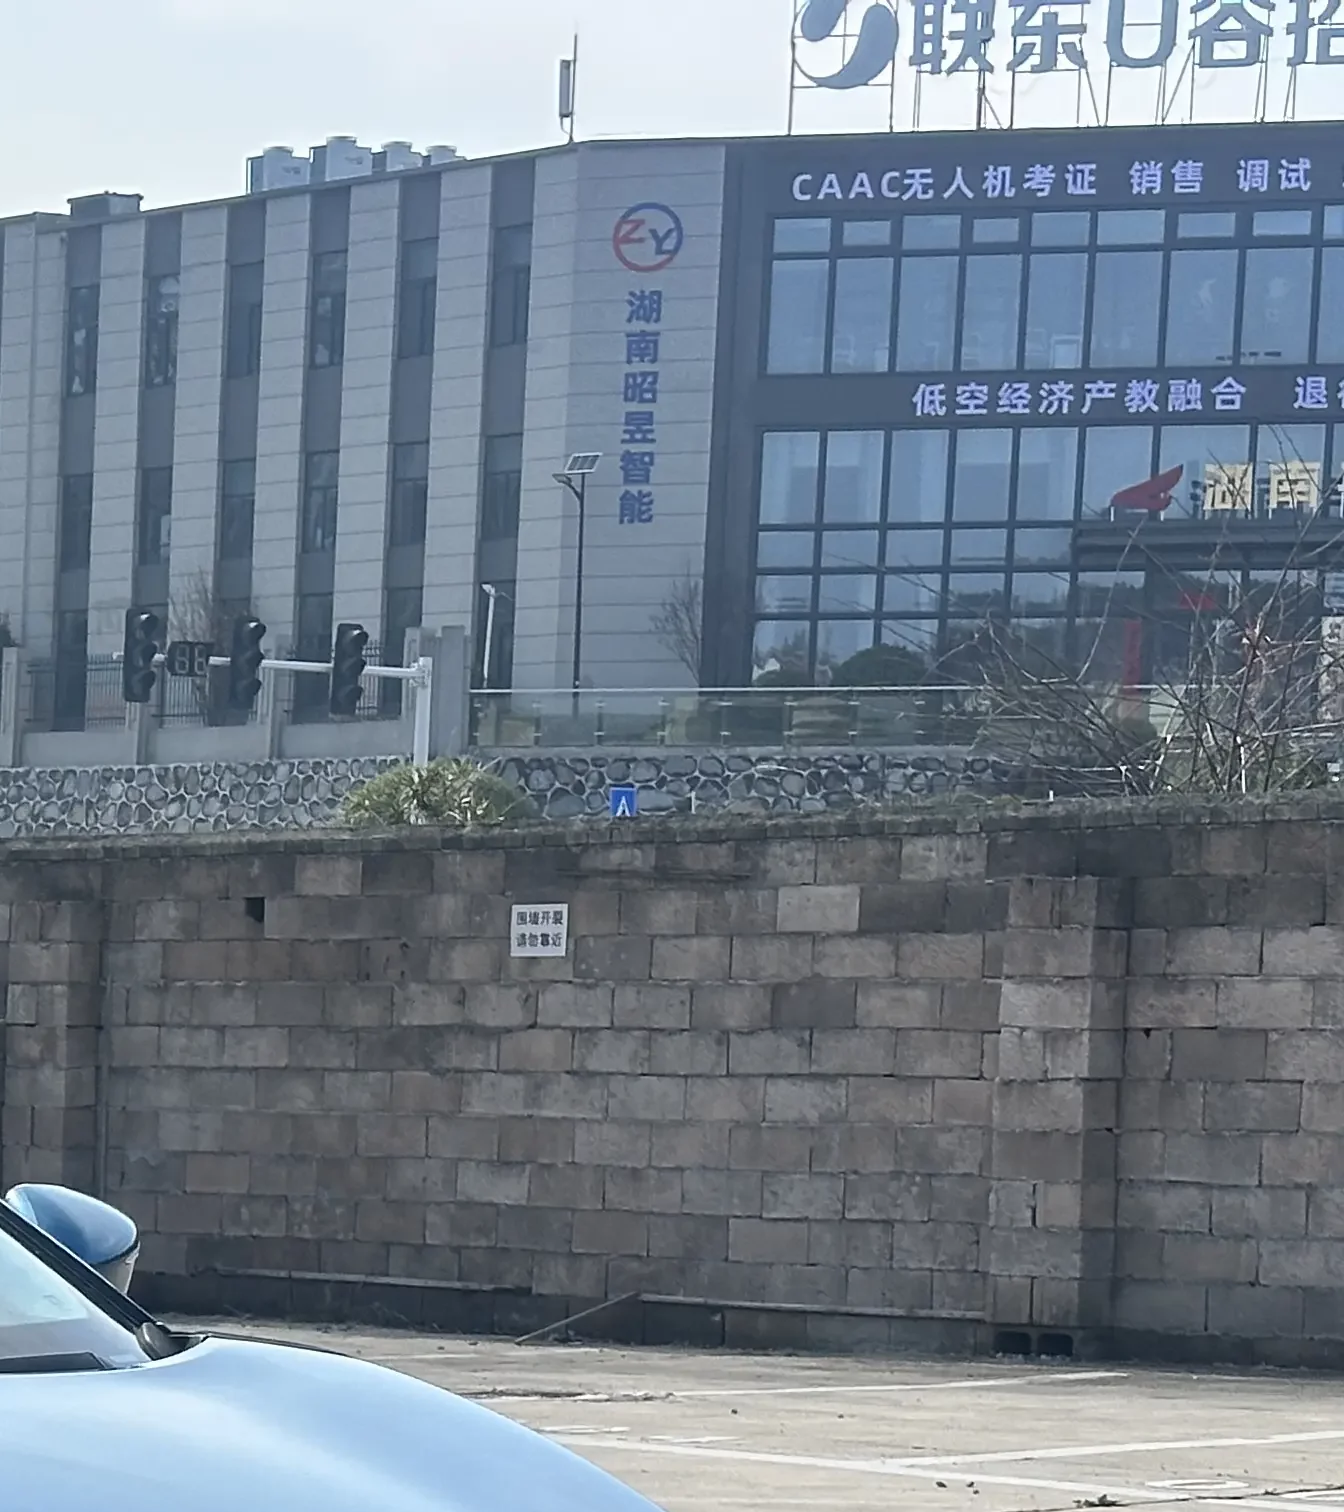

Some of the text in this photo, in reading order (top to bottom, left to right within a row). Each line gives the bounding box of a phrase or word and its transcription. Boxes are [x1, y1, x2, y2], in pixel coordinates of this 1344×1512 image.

[792, 157, 1311, 201] CAAC无人机考证 销售 调试
[618, 290, 662, 524] 湖南昭昱智能
[912, 376, 1247, 416] 低空经济产教融合
